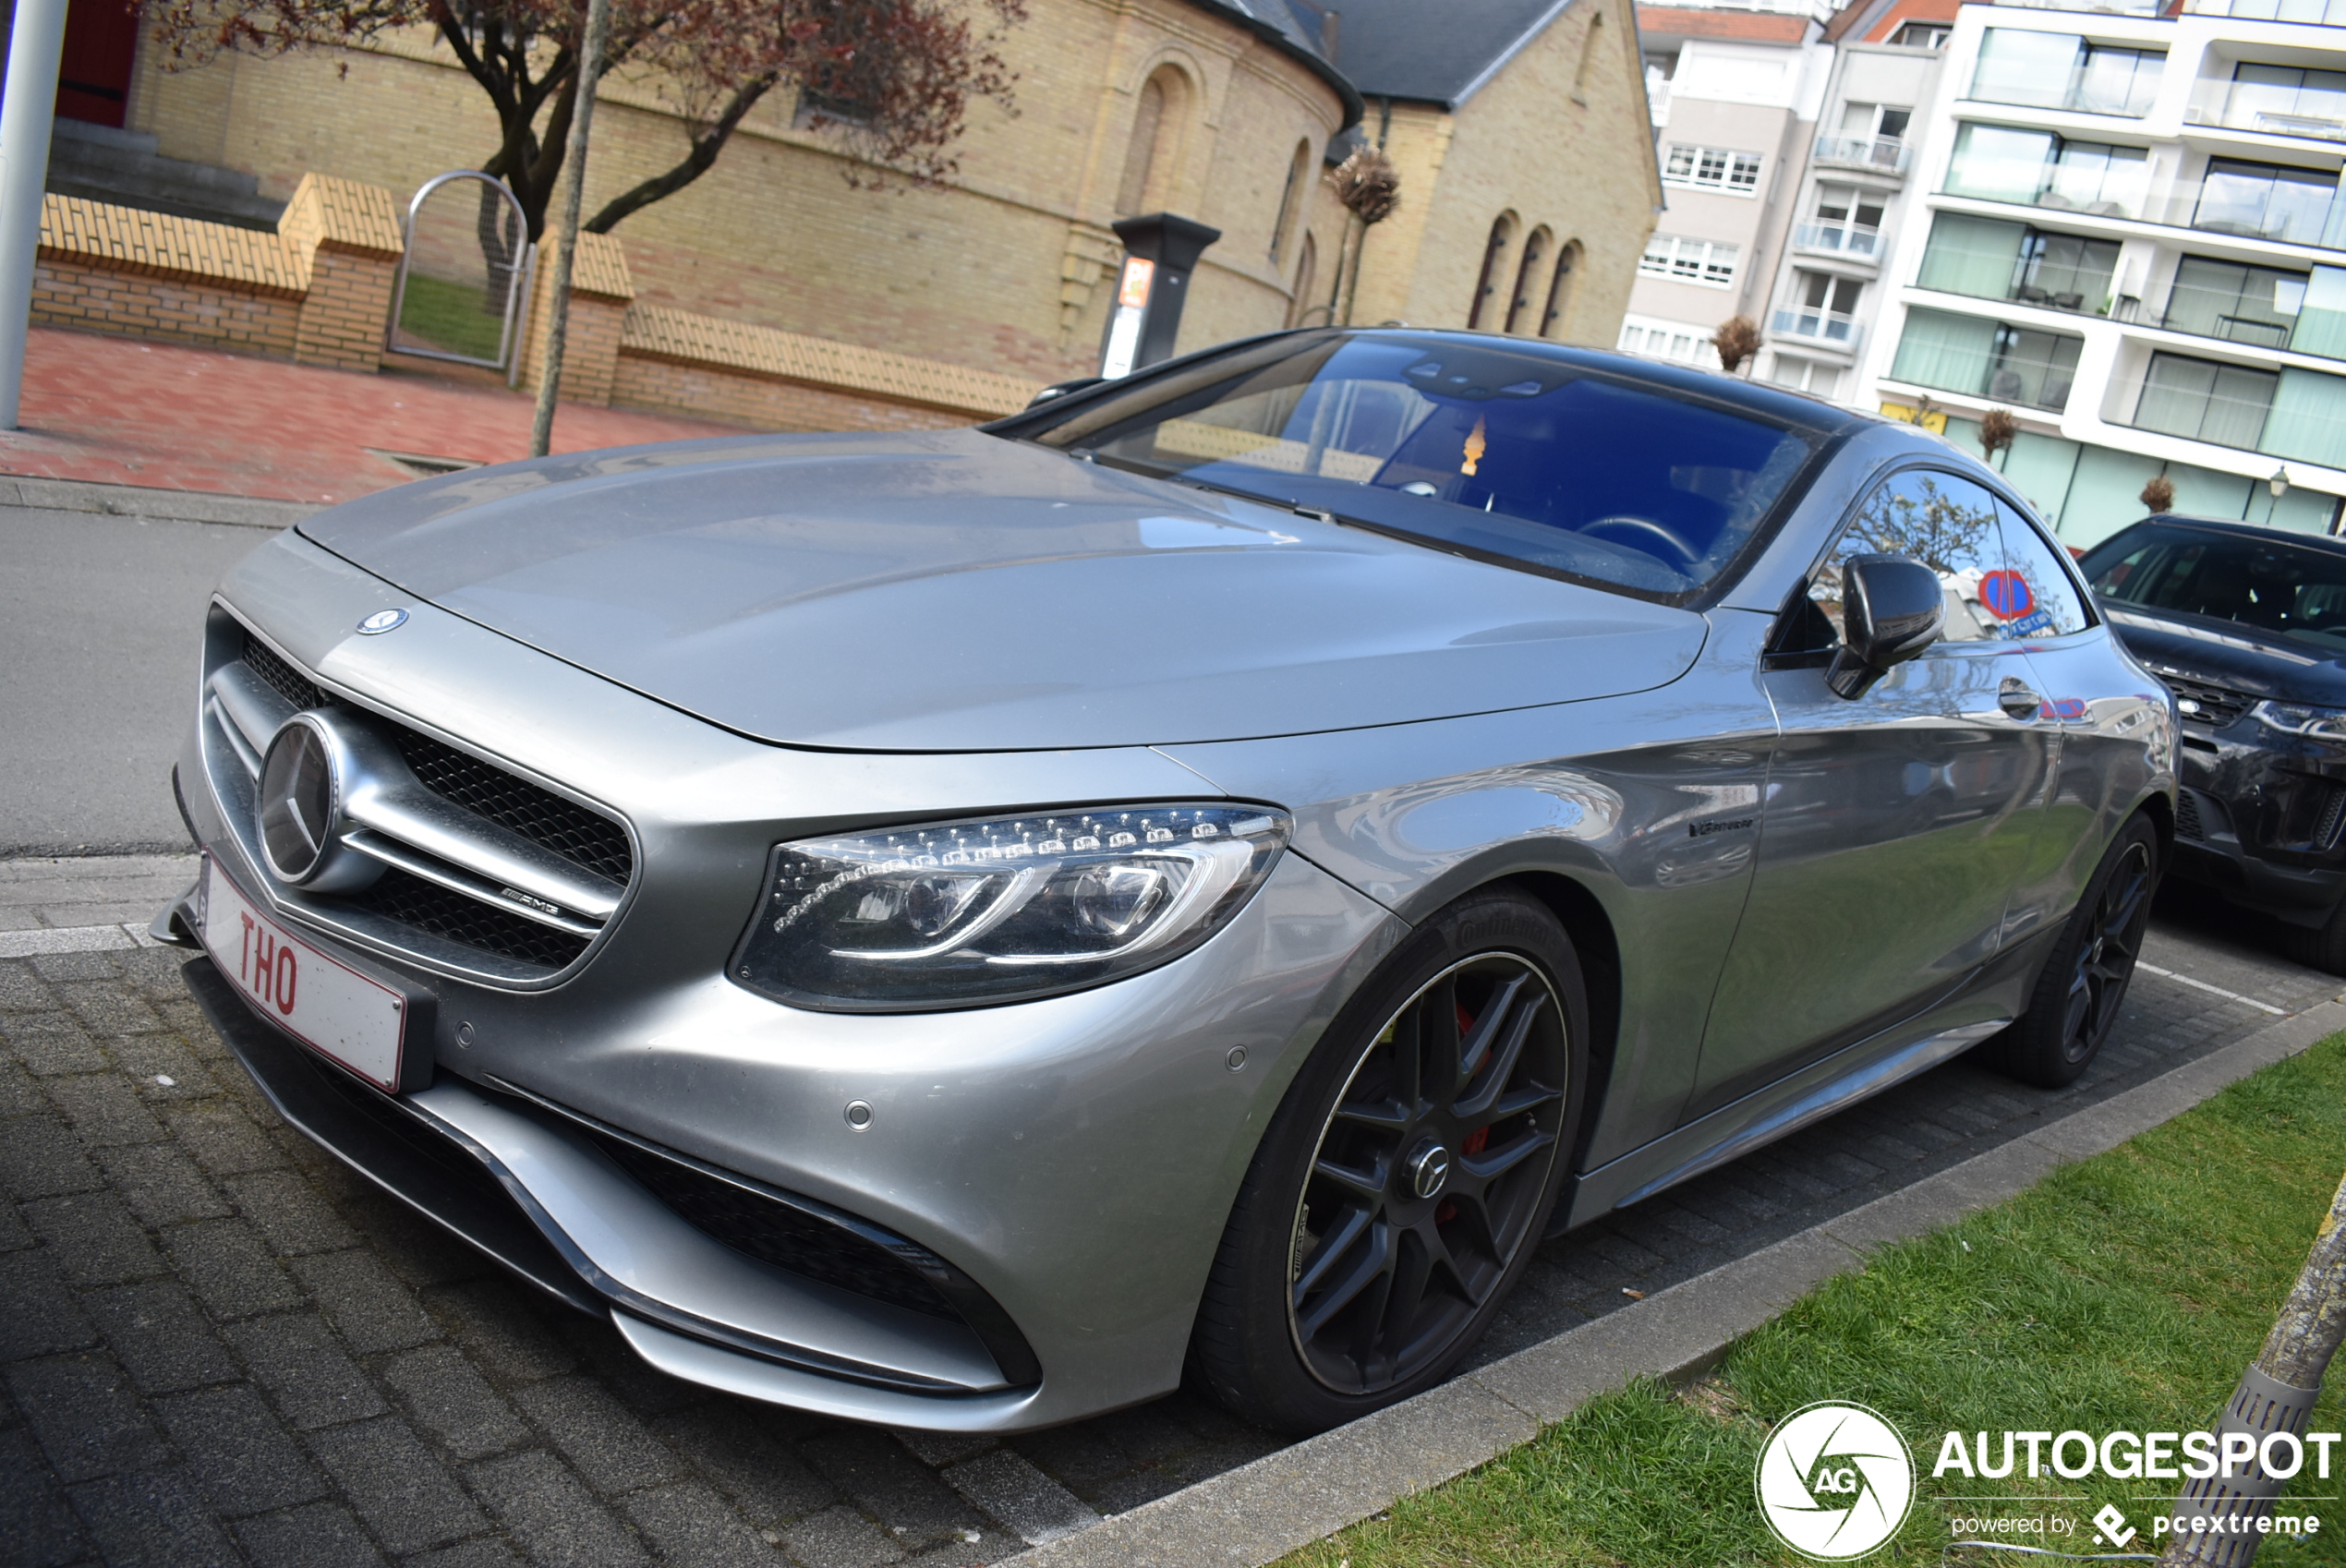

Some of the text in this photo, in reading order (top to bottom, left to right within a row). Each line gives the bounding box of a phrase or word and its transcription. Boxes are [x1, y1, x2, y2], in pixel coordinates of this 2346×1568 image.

[519, 893, 560, 916] AMG
[240, 910, 297, 1016] THO
[1296, 1208, 1309, 1253] AMG
